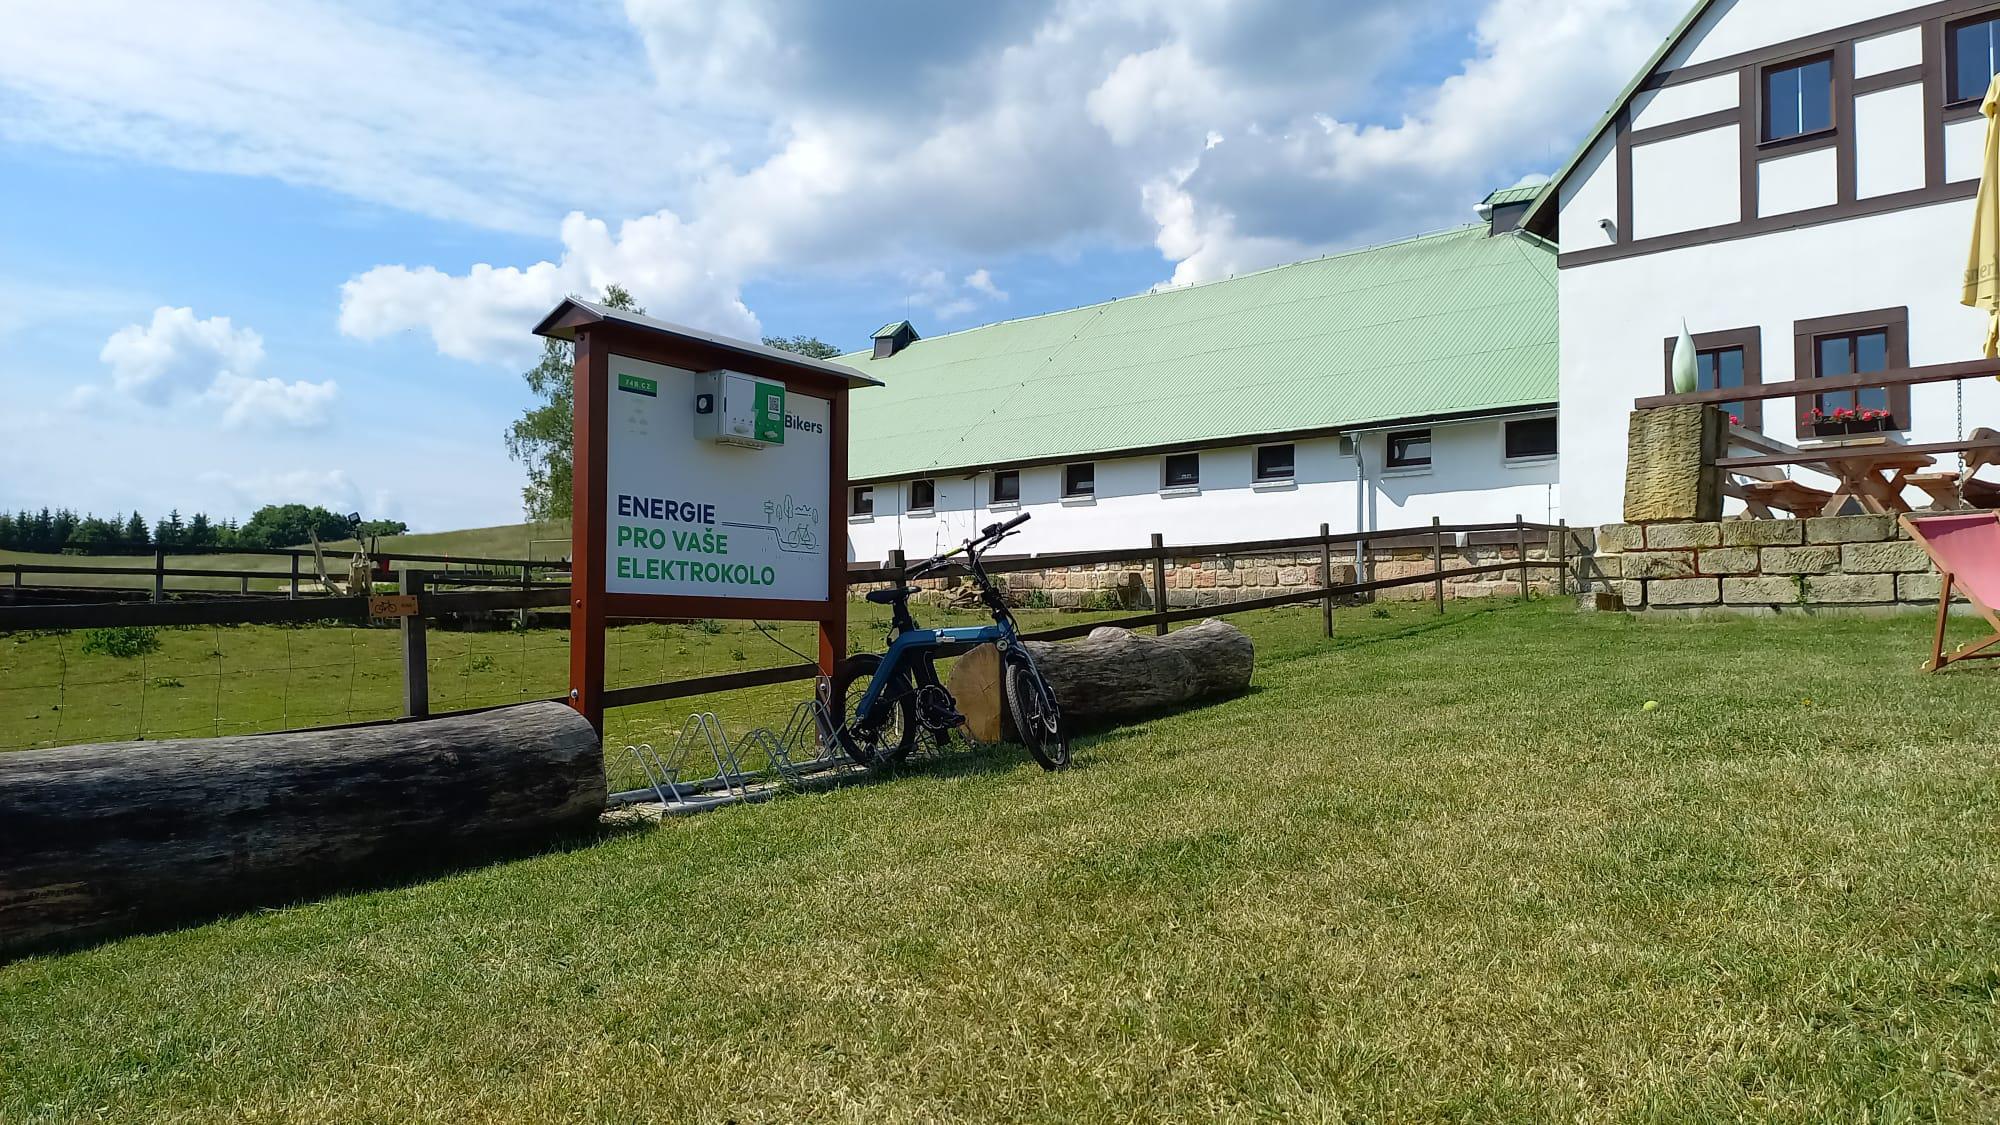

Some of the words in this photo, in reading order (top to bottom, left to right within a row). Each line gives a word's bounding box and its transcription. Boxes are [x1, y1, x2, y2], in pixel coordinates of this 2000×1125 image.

[784, 414, 823, 434] Bikers
[618, 494, 716, 525] ENERGIE
[617, 525, 666, 550] PRO
[672, 527, 728, 555] VAŠE
[617, 556, 775, 586] ELEKTROKOLO
